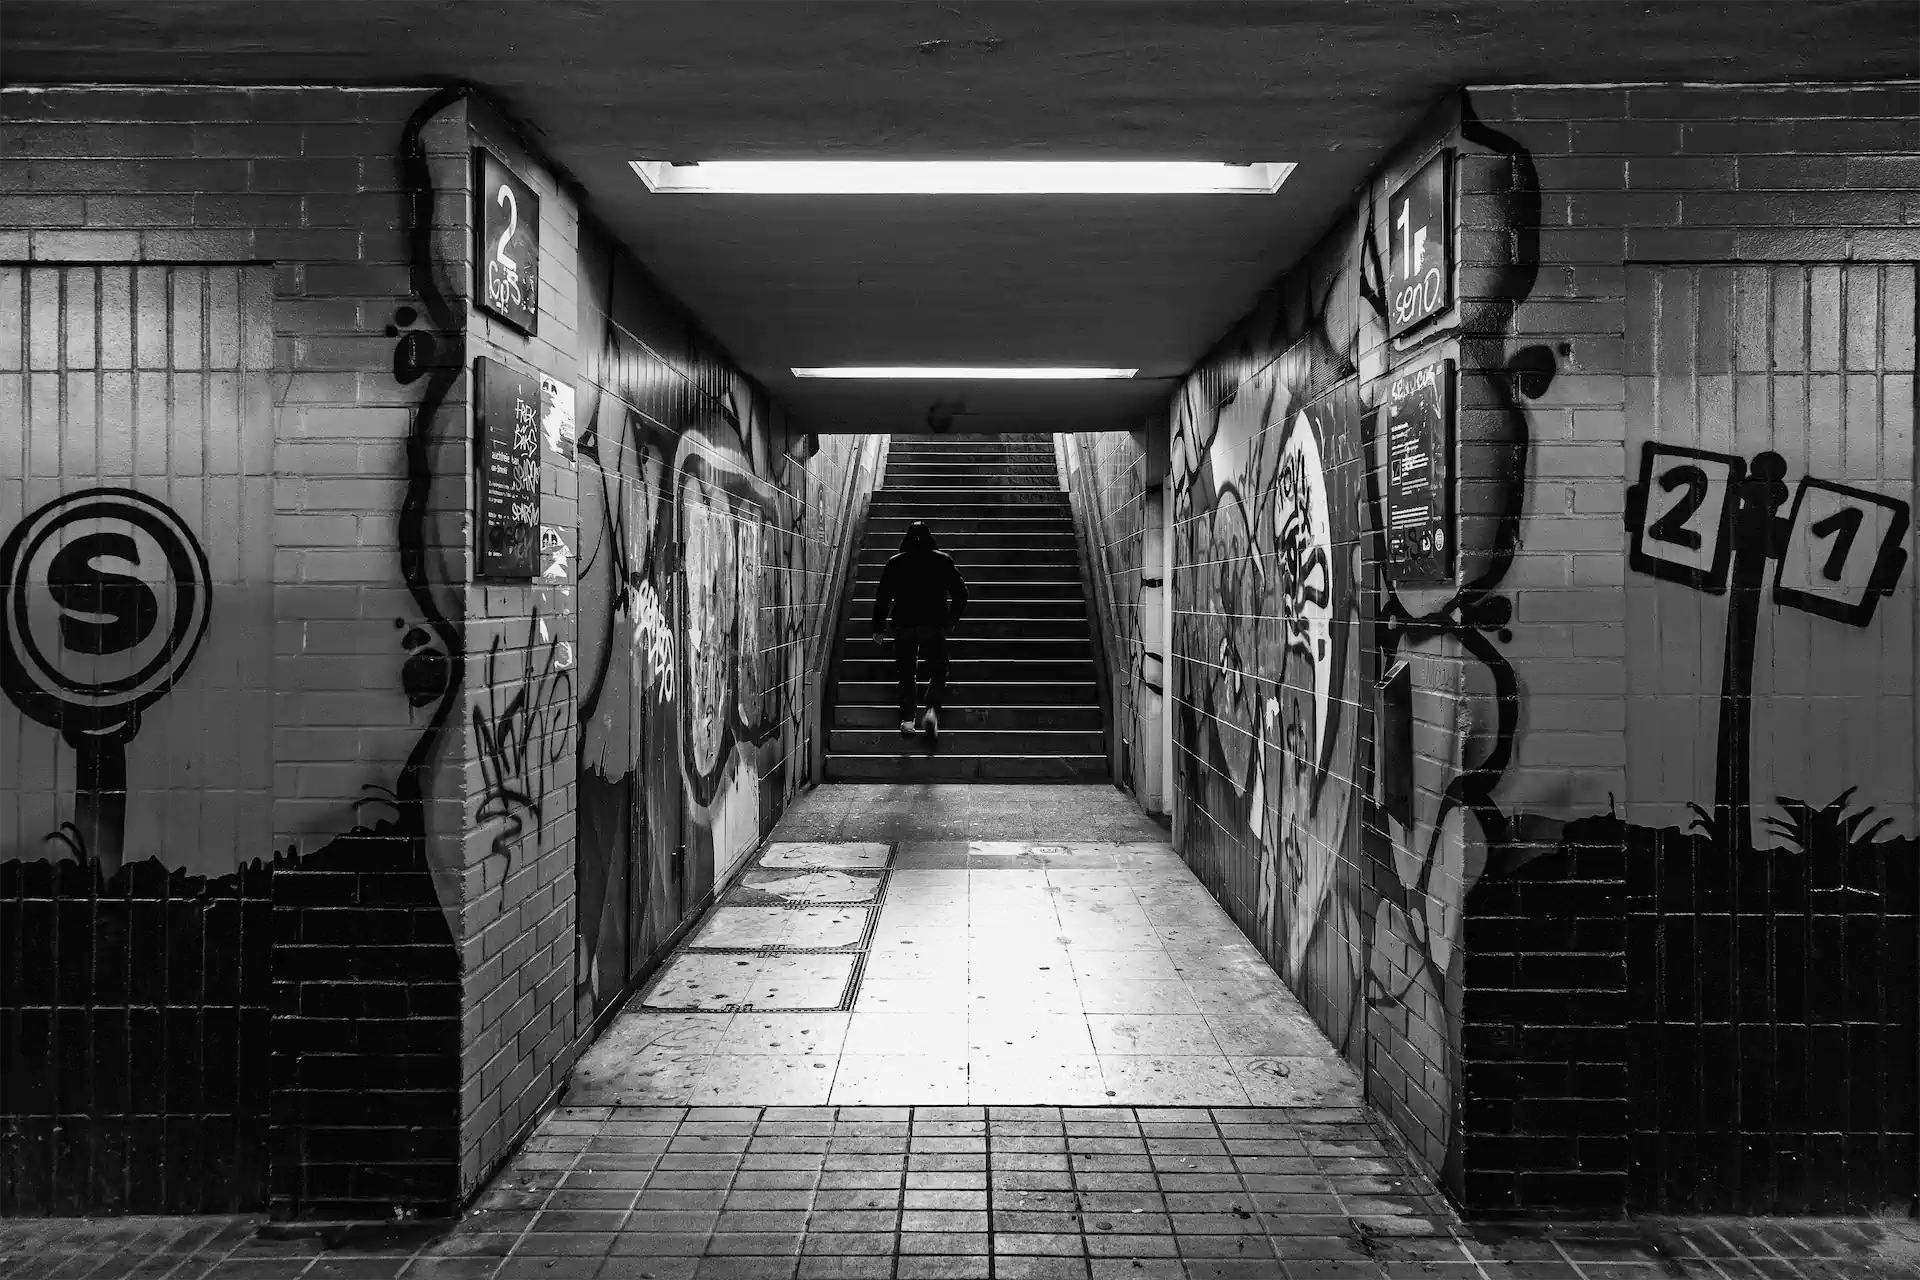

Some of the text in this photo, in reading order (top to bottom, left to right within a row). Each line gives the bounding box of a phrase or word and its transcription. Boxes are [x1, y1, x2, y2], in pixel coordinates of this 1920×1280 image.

[497, 184, 517, 272] 2
[1397, 197, 1410, 281] 1
[1648, 465, 1864, 582] 2 1
[47, 532, 158, 656] S
